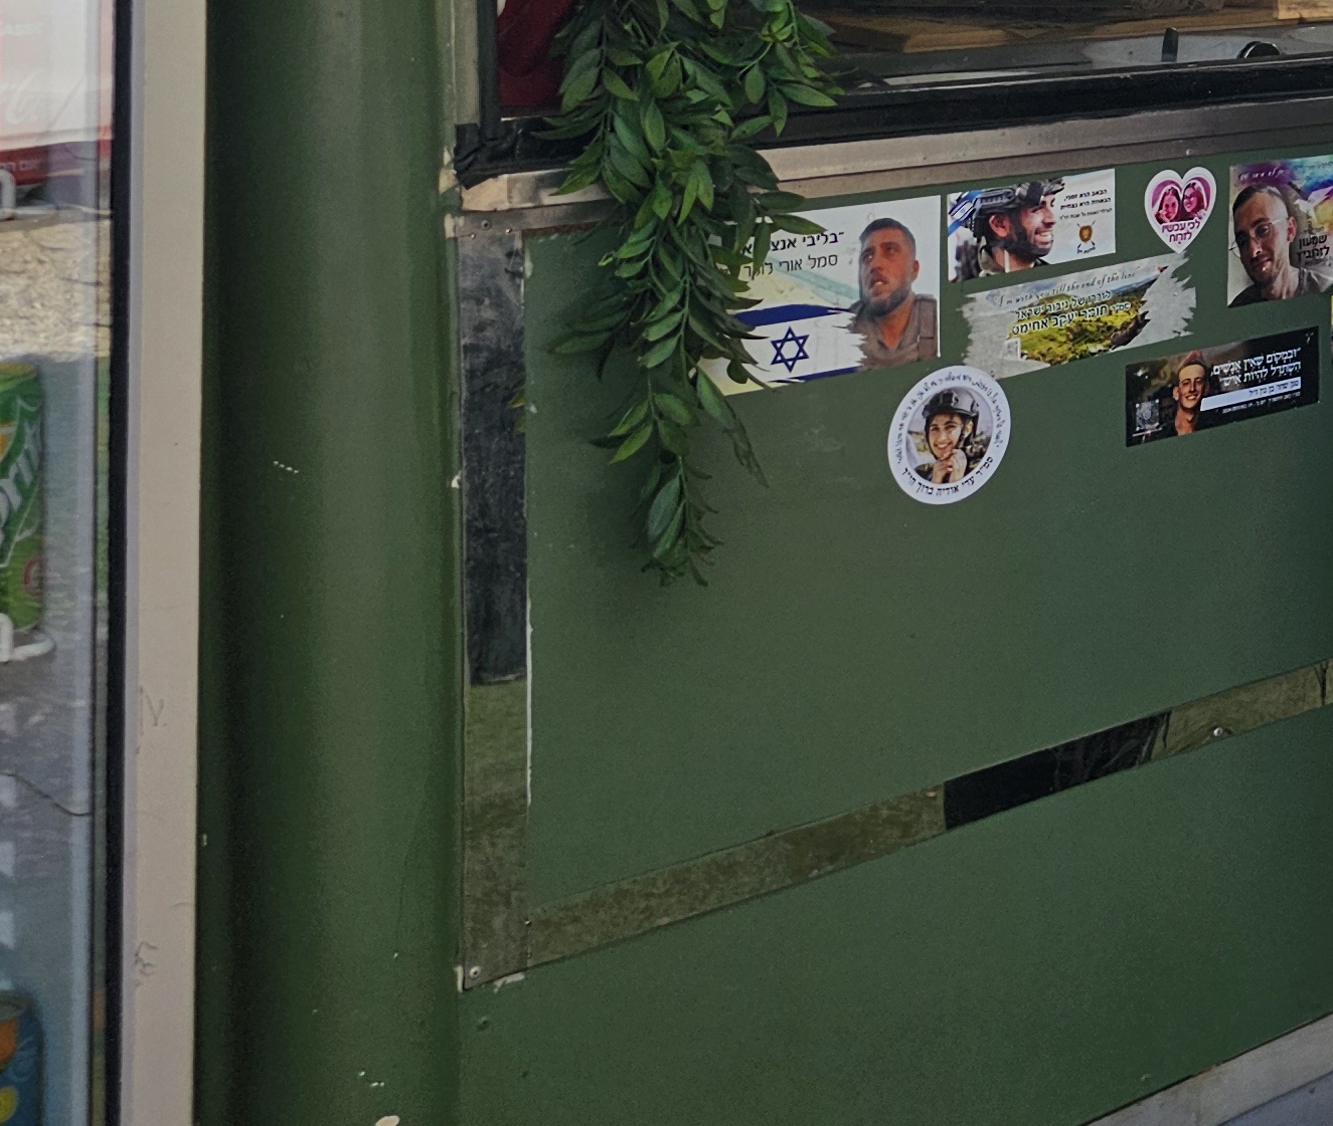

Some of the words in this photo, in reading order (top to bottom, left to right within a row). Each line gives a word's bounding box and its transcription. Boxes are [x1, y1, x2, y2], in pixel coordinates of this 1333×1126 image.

[1161, 221, 1186, 234] עכשיו
[1187, 218, 1201, 231] לכי
[778, 258, 803, 273] אורי
[807, 253, 839, 269] סמל
[1015, 293, 1033, 305] with
[1071, 294, 1085, 307] של
[1086, 290, 1112, 305] לזכרו
[1014, 304, 1047, 322] ישראל
[1051, 310, 1079, 328] יעקב
[1081, 304, 1109, 321] תומר
